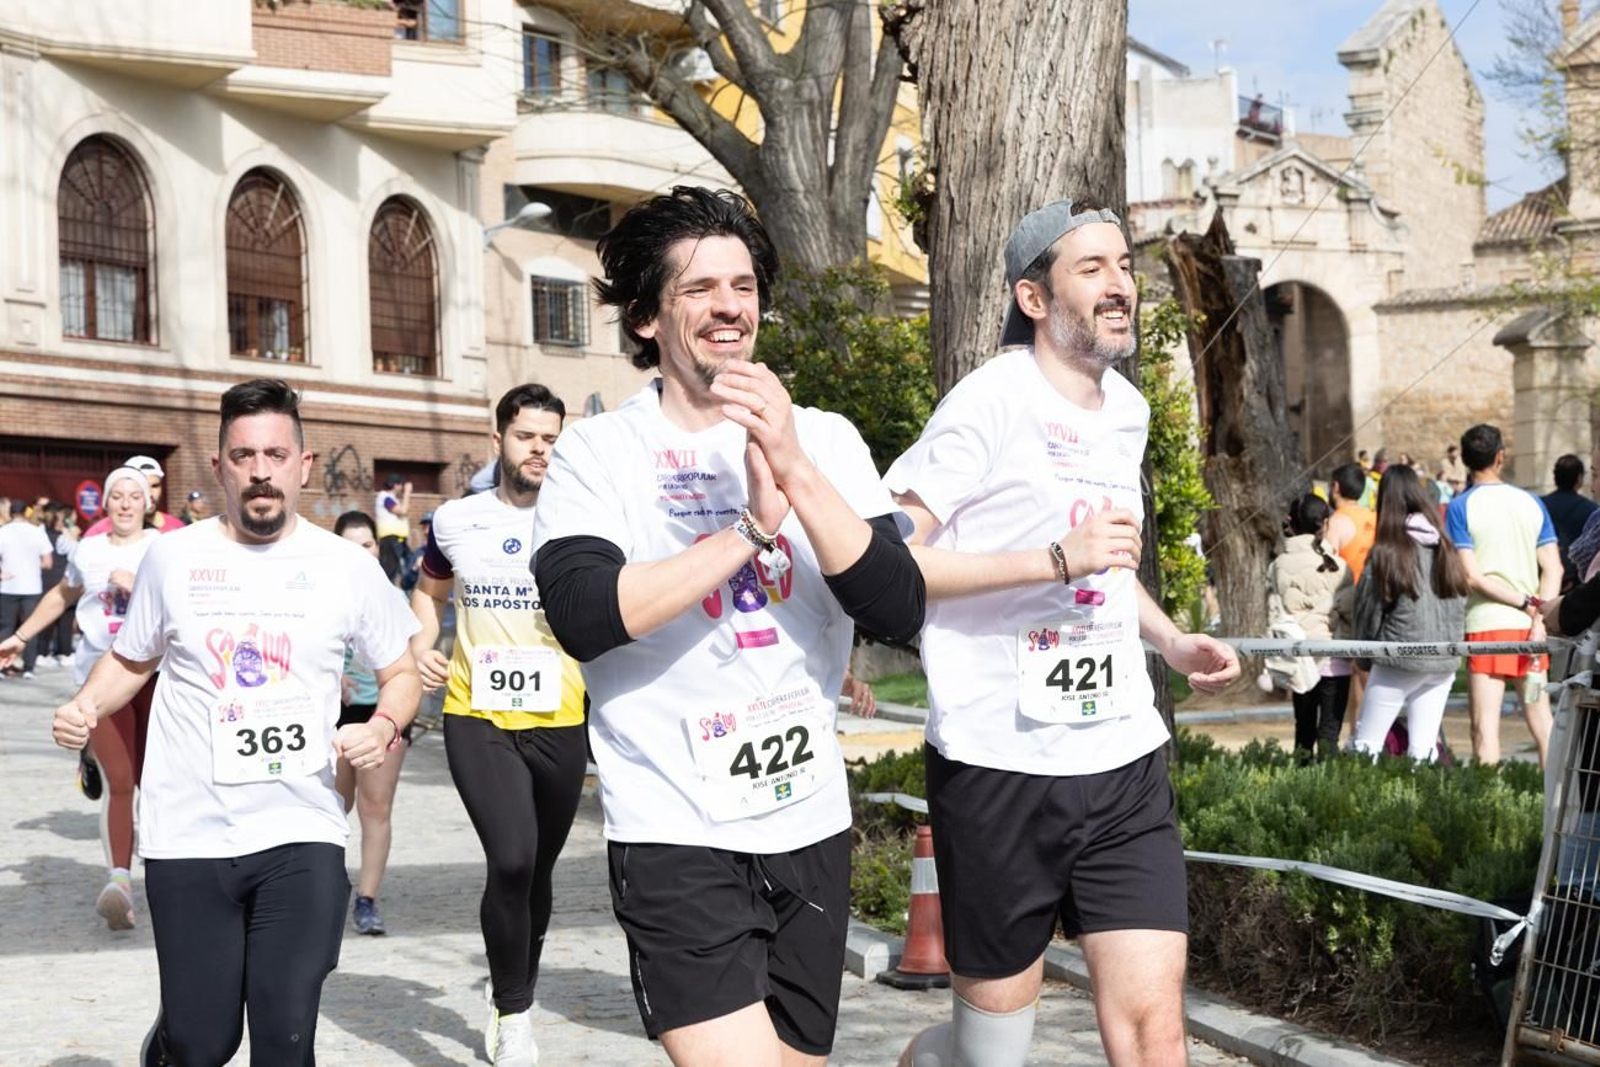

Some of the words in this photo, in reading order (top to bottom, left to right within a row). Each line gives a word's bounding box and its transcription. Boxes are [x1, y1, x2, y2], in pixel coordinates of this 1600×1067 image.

[189, 569, 227, 582] XXVII
[464, 585, 510, 595] SANTA
[1397, 646, 1440, 656] DEPORTES
[490, 669, 541, 691] 901
[1045, 654, 1112, 692] 421
[236, 723, 306, 756] 363
[729, 725, 815, 779] 422
[752, 781, 768, 790] JOSE
